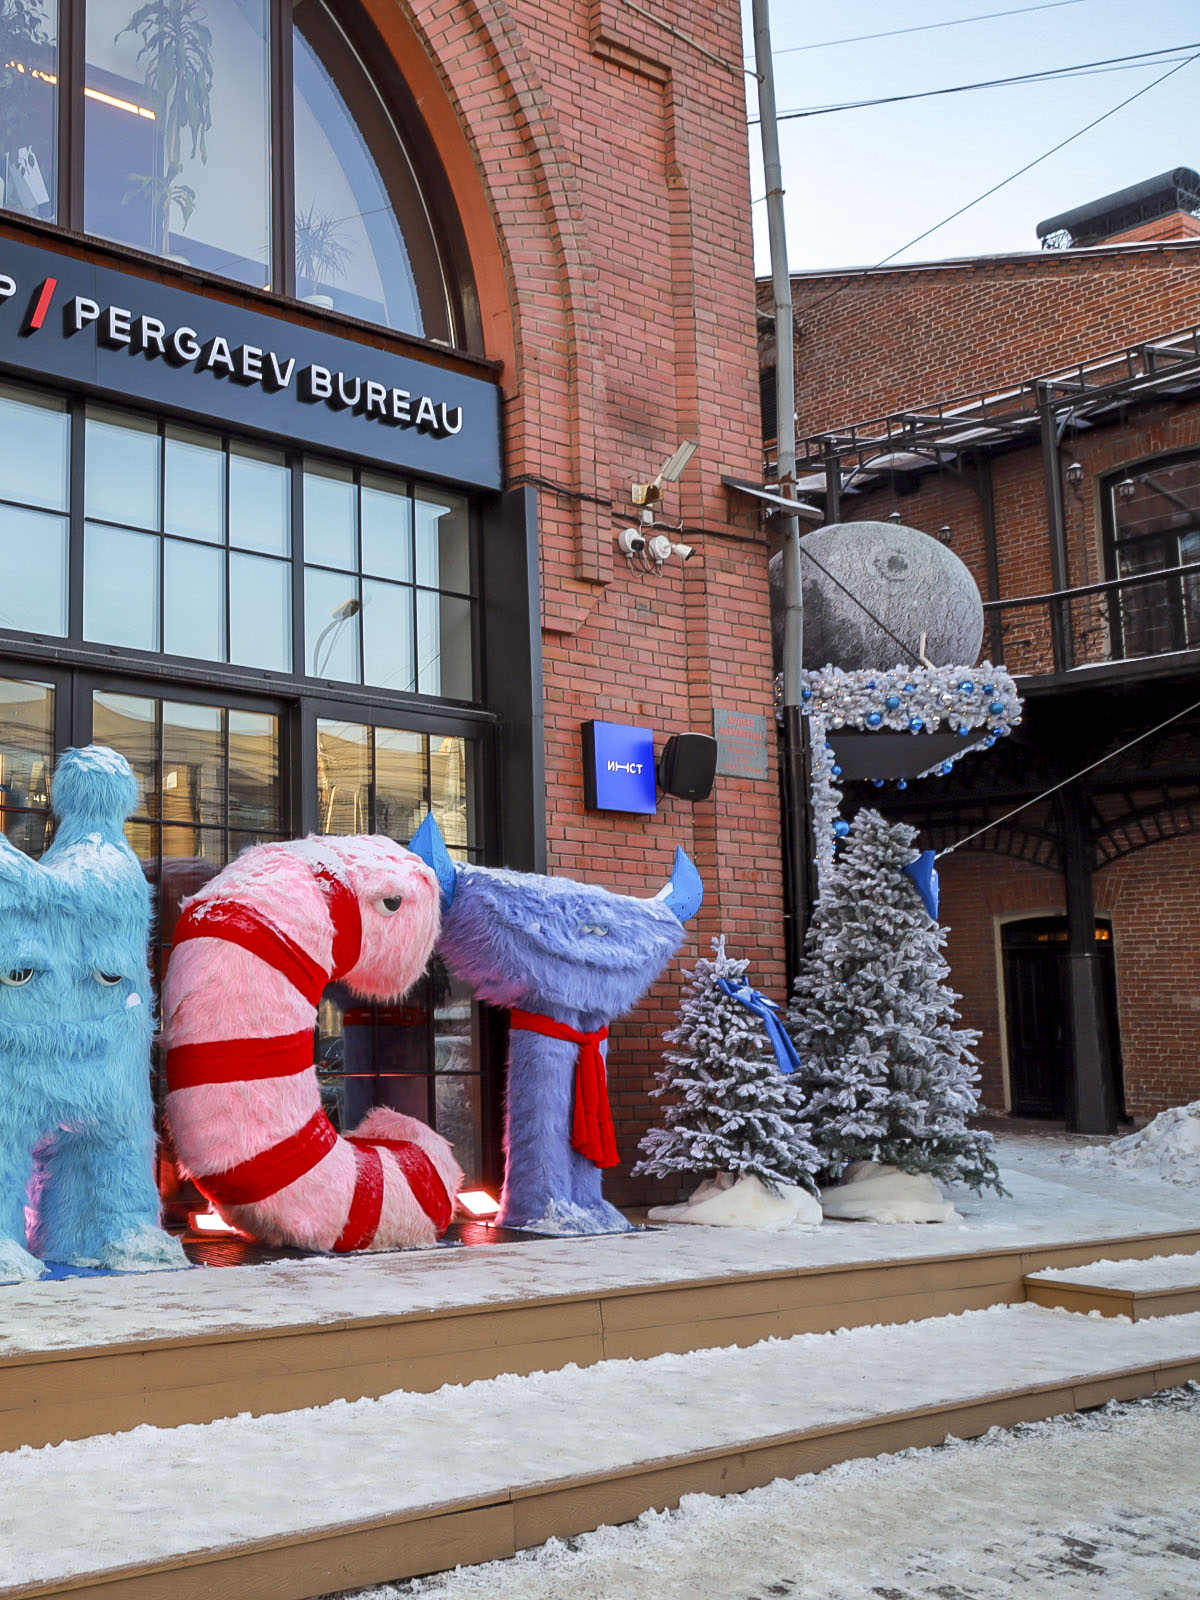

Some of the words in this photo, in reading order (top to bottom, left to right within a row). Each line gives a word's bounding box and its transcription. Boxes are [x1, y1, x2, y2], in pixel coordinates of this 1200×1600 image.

[74, 295, 296, 387] PERGAEV
[310, 363, 464, 435] BUREAU
[607, 760, 643, 775] ИНСТ
